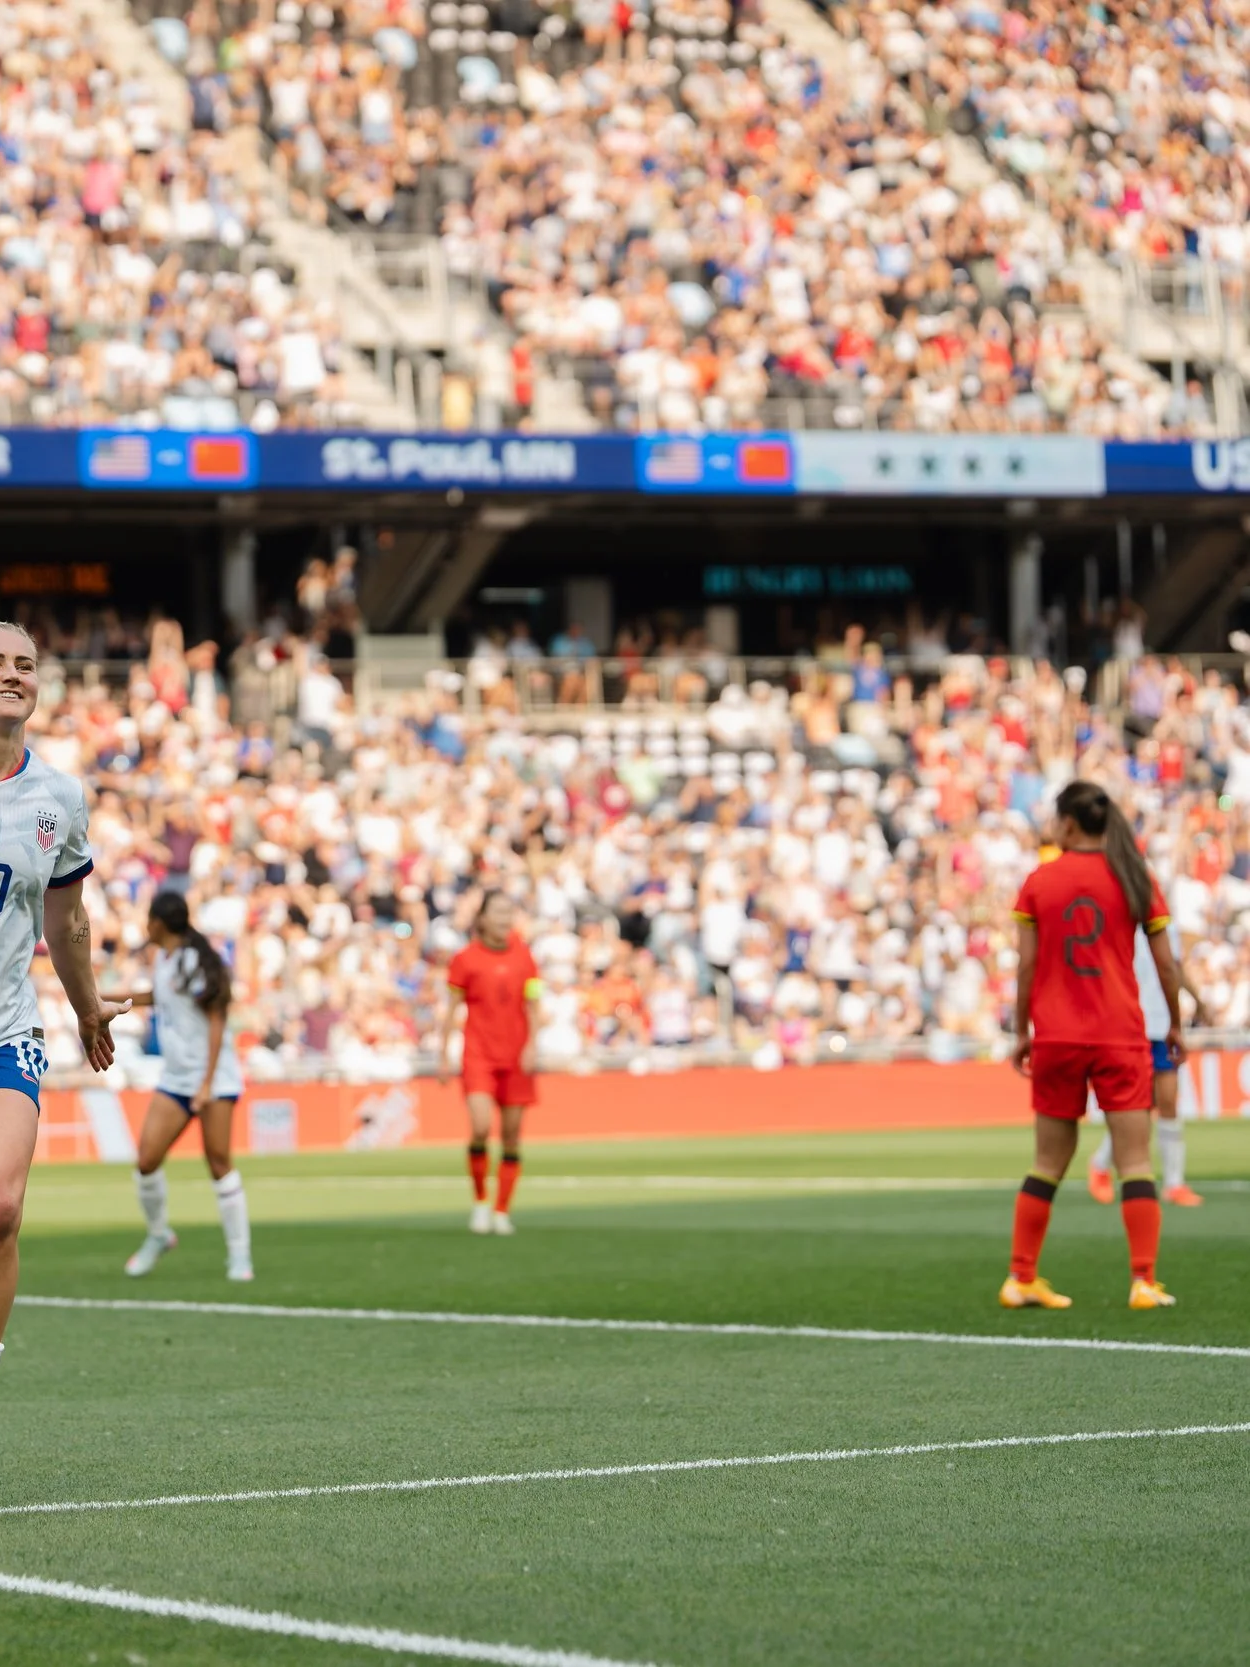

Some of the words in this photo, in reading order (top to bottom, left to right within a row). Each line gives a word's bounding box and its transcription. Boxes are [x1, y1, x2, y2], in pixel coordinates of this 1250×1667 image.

[322, 439, 387, 481] St.
[502, 440, 576, 482] MN
[39, 819, 55, 833] USA
[1063, 896, 1104, 976] 2
